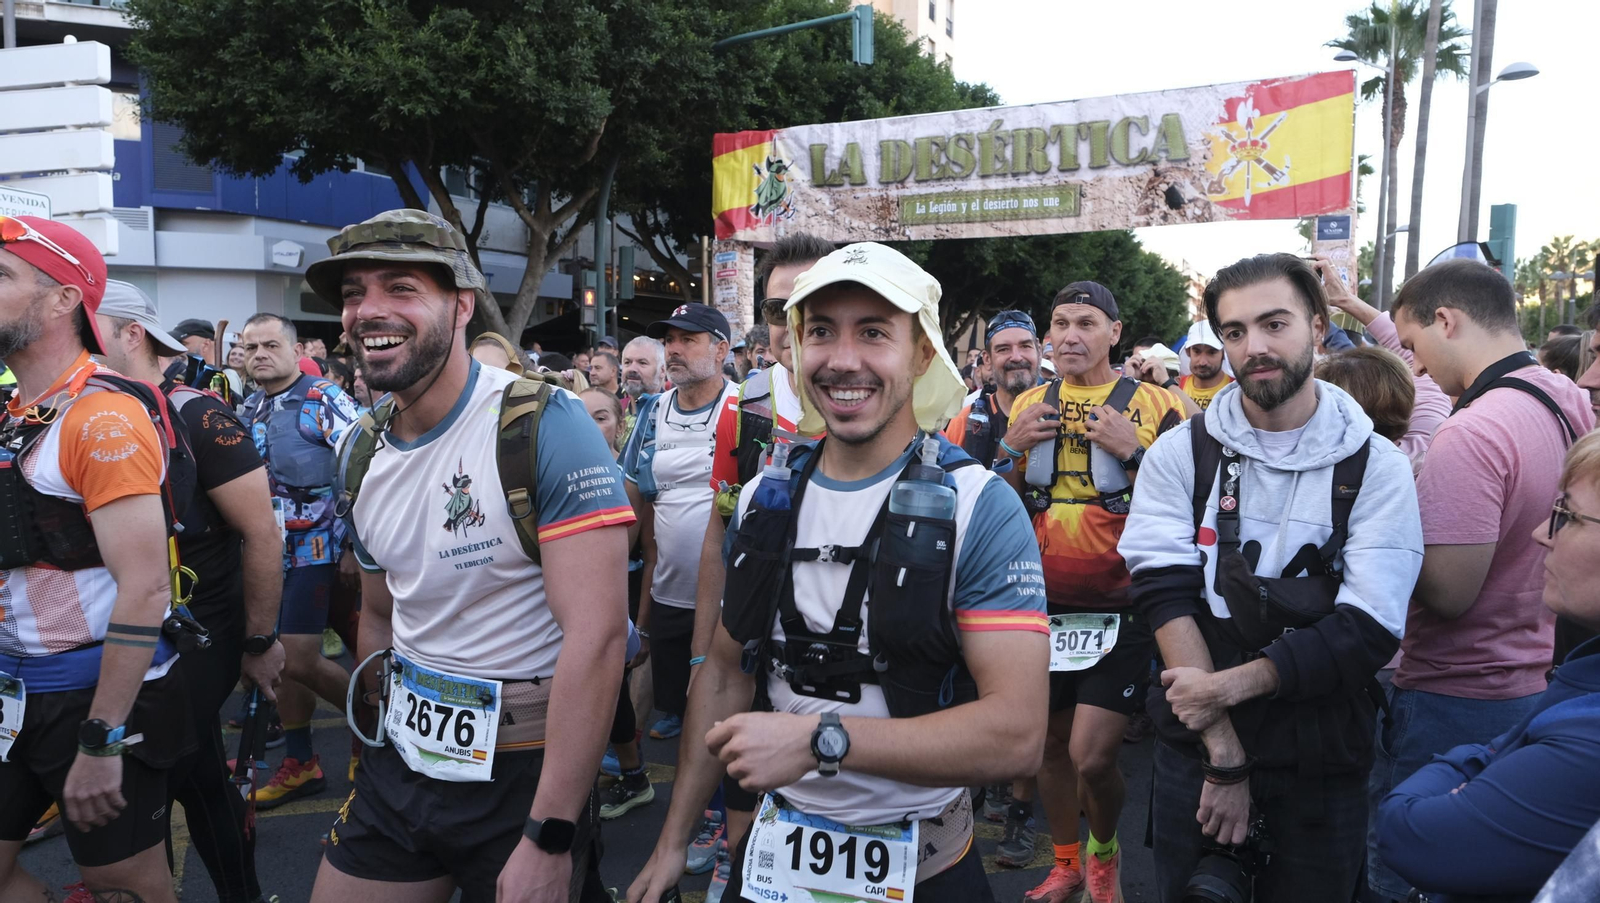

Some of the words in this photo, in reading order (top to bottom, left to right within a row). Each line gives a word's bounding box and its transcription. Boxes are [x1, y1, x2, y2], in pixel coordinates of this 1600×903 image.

[809, 142, 867, 187] LA
[878, 112, 1192, 184] DESÉRTICA
[0, 193, 46, 209] VENIDA
[916, 202, 926, 214] La
[929, 200, 957, 215] Legión
[961, 202, 968, 214] y
[971, 198, 980, 211] el
[983, 197, 1019, 211] desierto
[1022, 197, 1039, 208] nos
[1043, 196, 1060, 207] une
[566, 471, 579, 481] LA
[580, 476, 616, 490] DESIERTO
[579, 490, 596, 502] NOS
[596, 487, 613, 497] UNE
[439, 549, 450, 559] LA
[451, 537, 503, 557] DESÉRTICA
[464, 556, 494, 569] EDICIÓN
[1055, 630, 1103, 652] 5071
[405, 691, 477, 748] 2676
[444, 745, 472, 757] ANUBIS
[785, 826, 890, 884] 1919
[756, 874, 773, 884] BUS
[864, 885, 885, 897] CAPI
